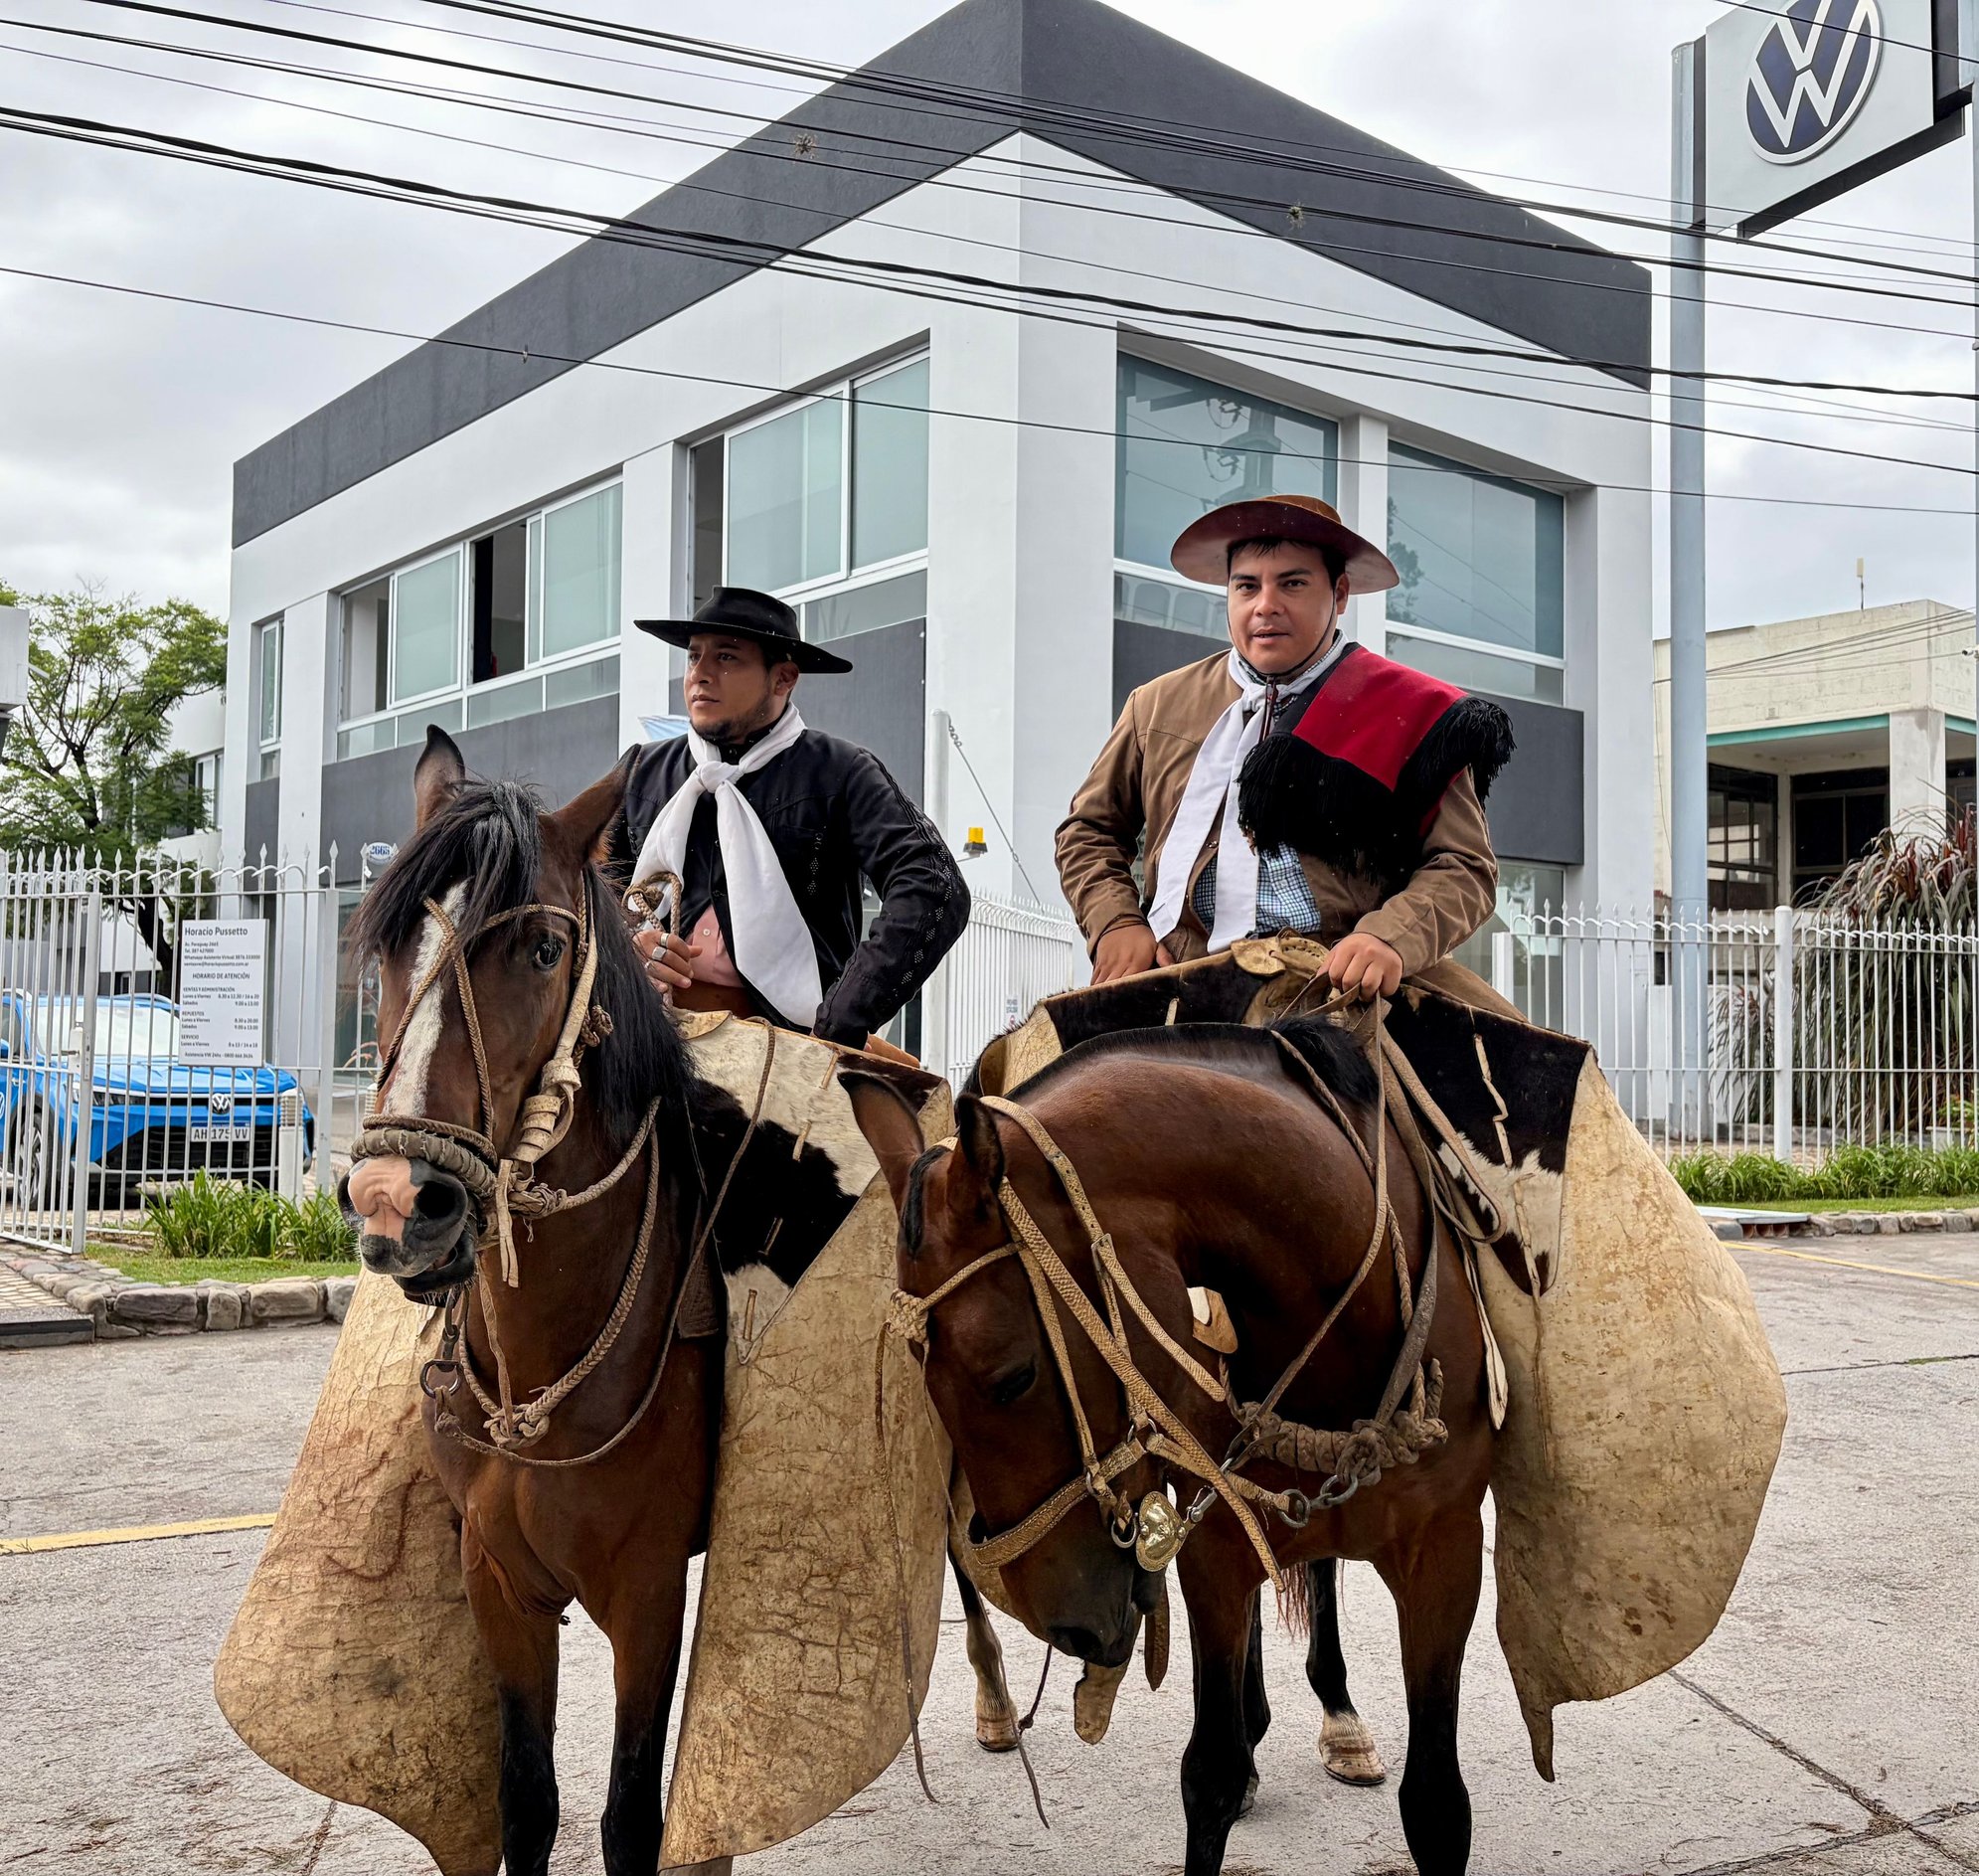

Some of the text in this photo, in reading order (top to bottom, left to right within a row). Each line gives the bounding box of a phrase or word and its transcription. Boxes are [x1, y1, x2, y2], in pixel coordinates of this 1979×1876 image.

[185, 927, 248, 936] Horacio Pussetto
[194, 1128, 247, 1139] AH 175 VV
